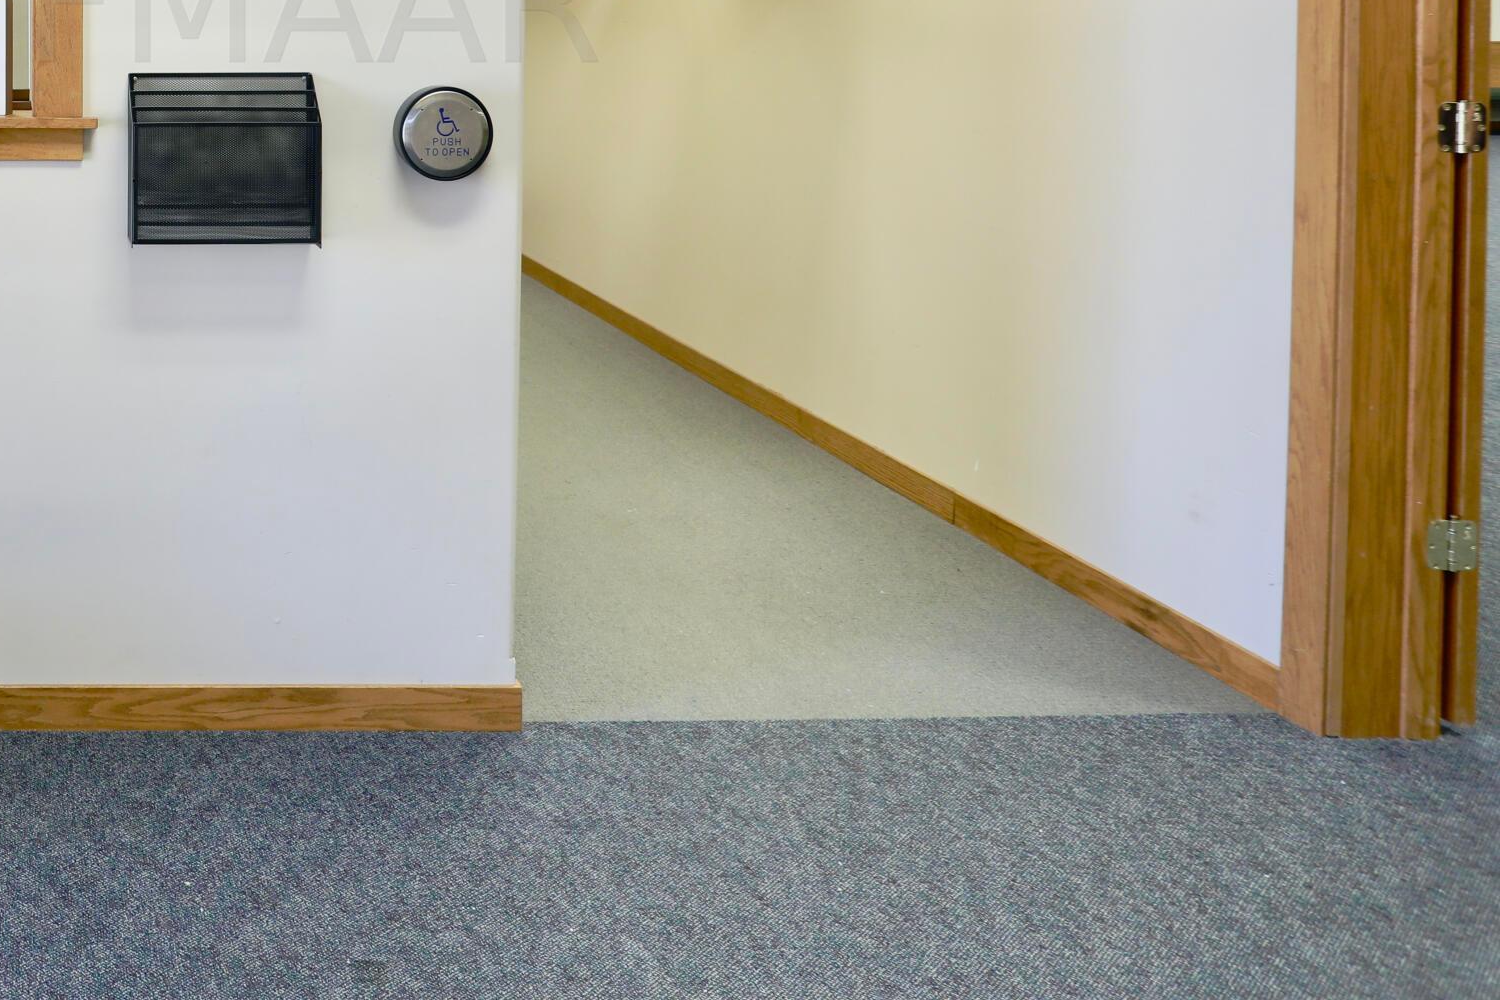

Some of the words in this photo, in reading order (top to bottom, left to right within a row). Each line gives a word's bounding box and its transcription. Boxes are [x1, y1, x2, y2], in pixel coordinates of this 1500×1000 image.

[432, 138, 462, 147] PUSH
[425, 148, 439, 156] TO
[441, 148, 470, 156] OPEN
